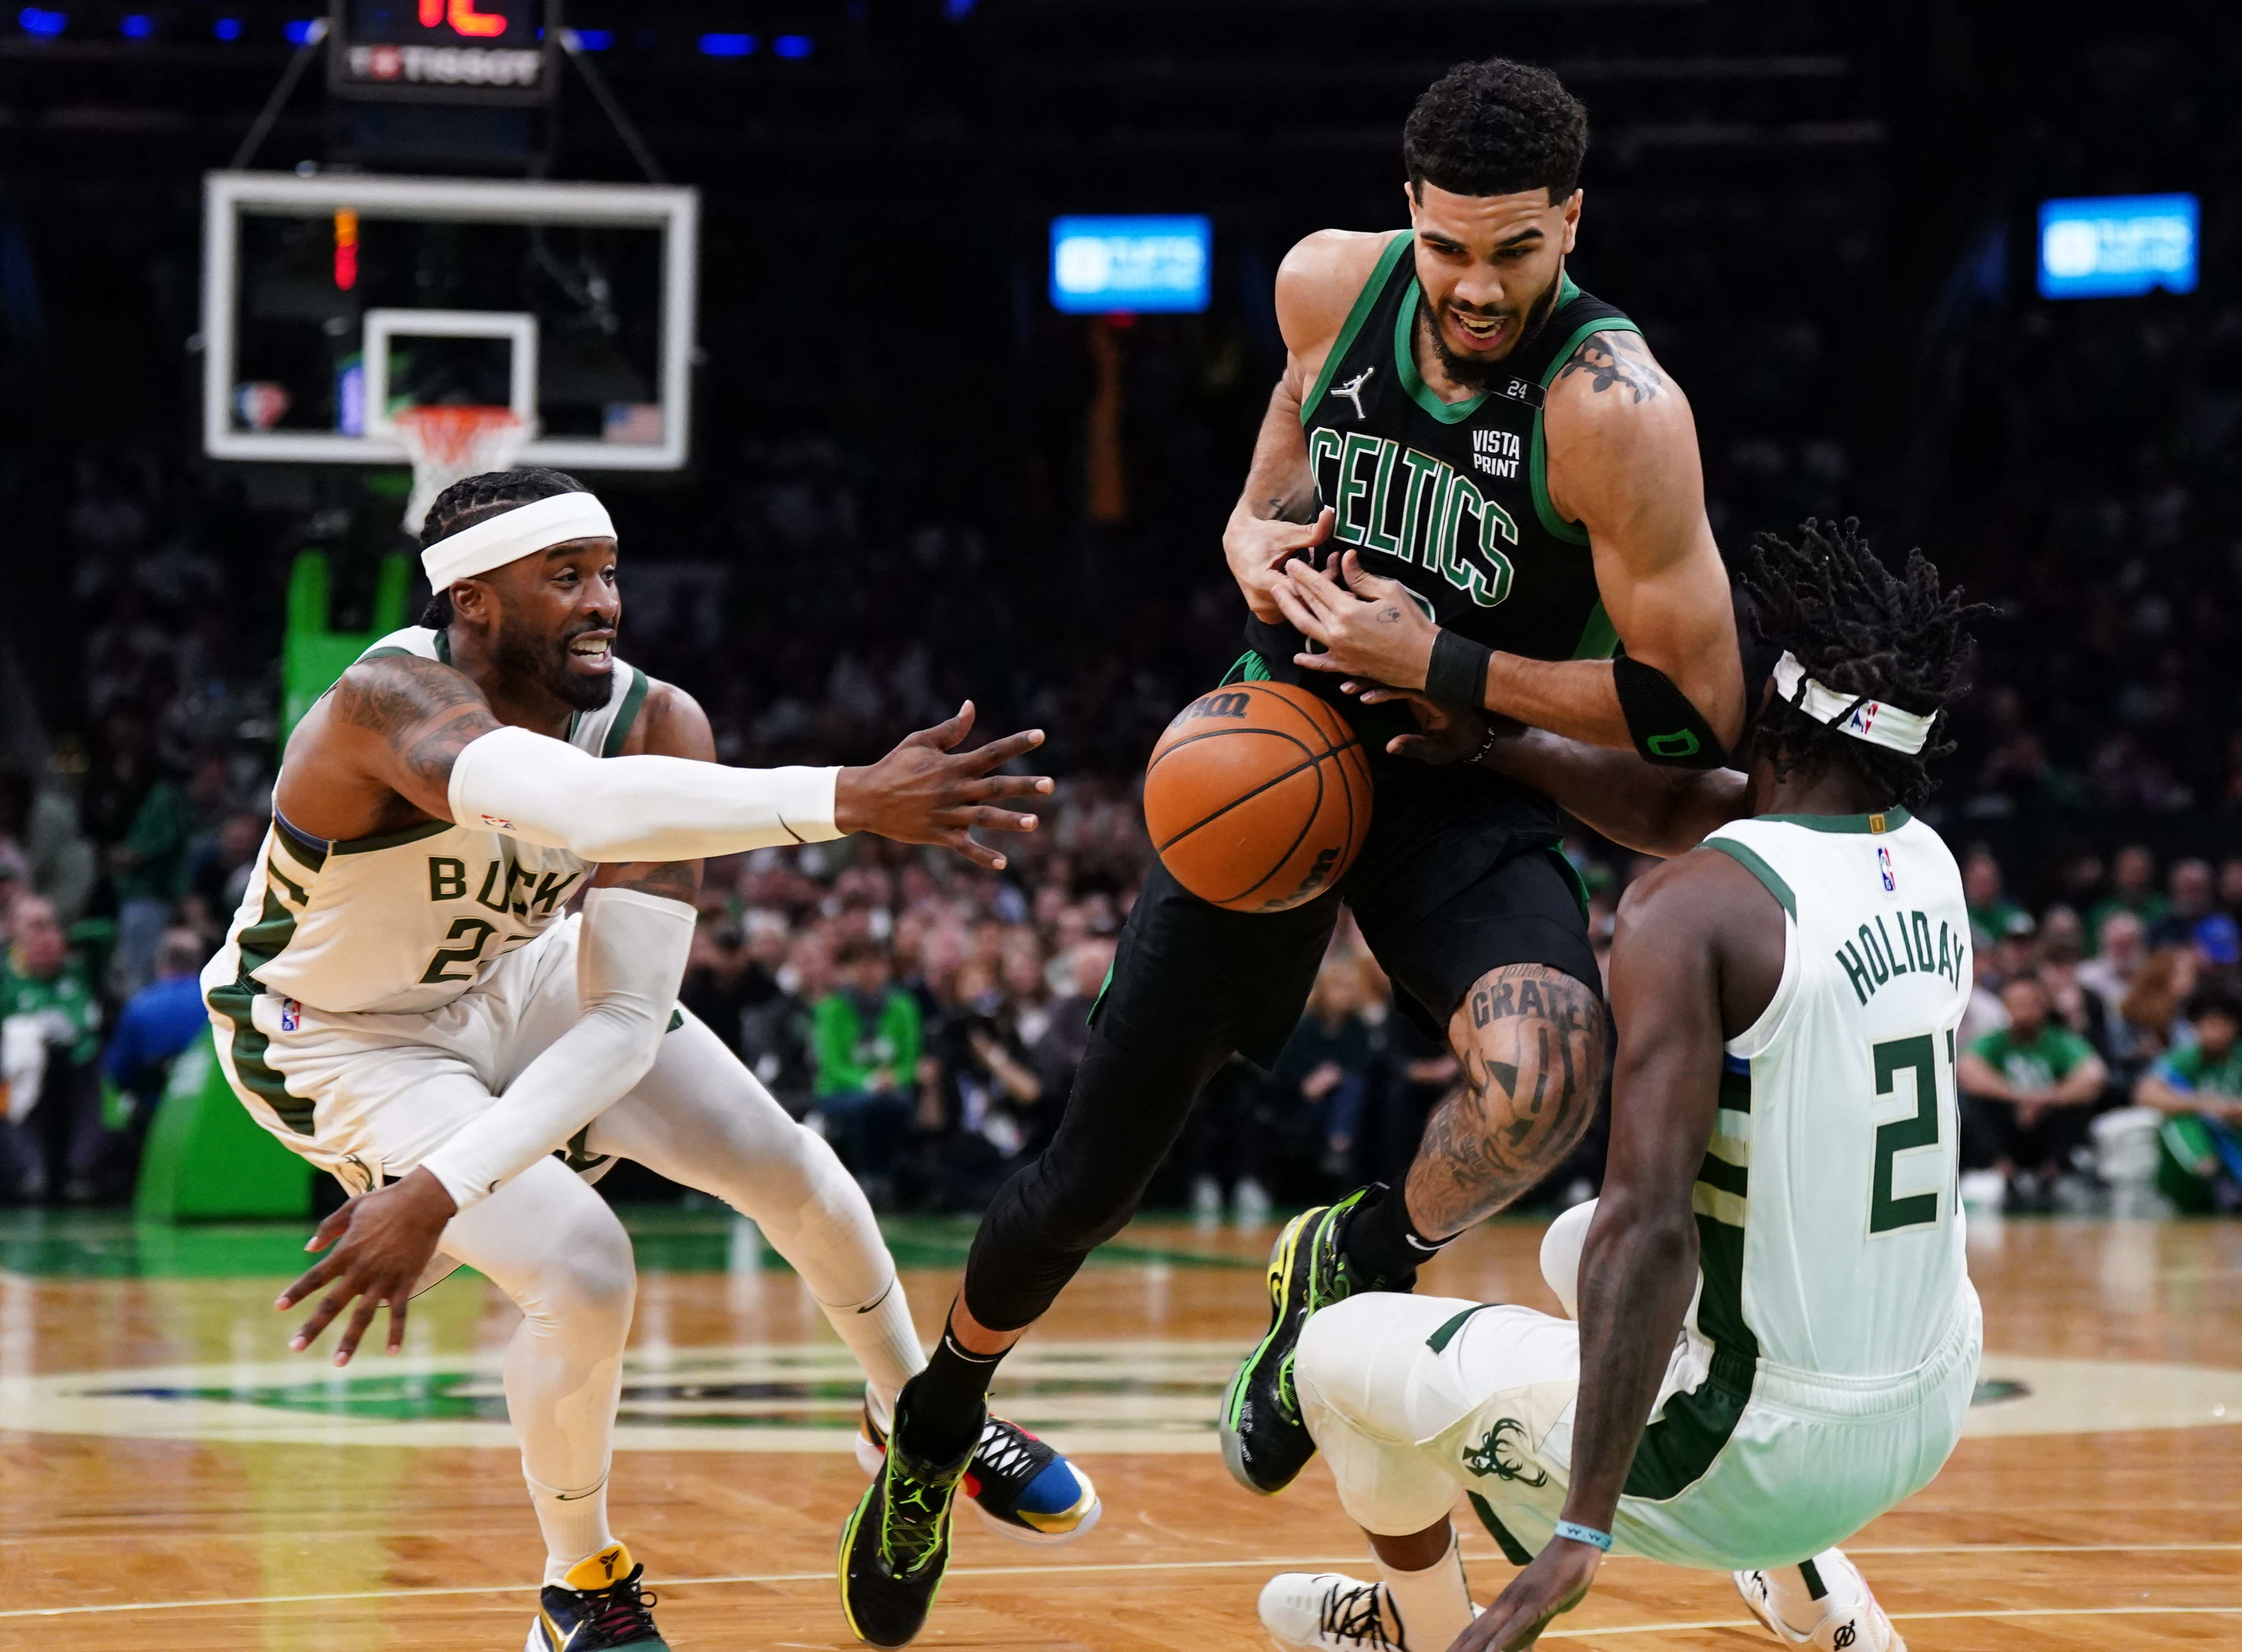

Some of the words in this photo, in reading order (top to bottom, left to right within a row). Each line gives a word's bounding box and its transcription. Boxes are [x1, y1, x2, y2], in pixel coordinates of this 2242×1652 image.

[1507, 380, 1528, 399] 24
[1472, 430, 1520, 460] VISTA
[1473, 453, 1520, 479] PRINT
[1309, 427, 1519, 608] CELTICS
[1835, 909, 1965, 1006] HOLIDAY
